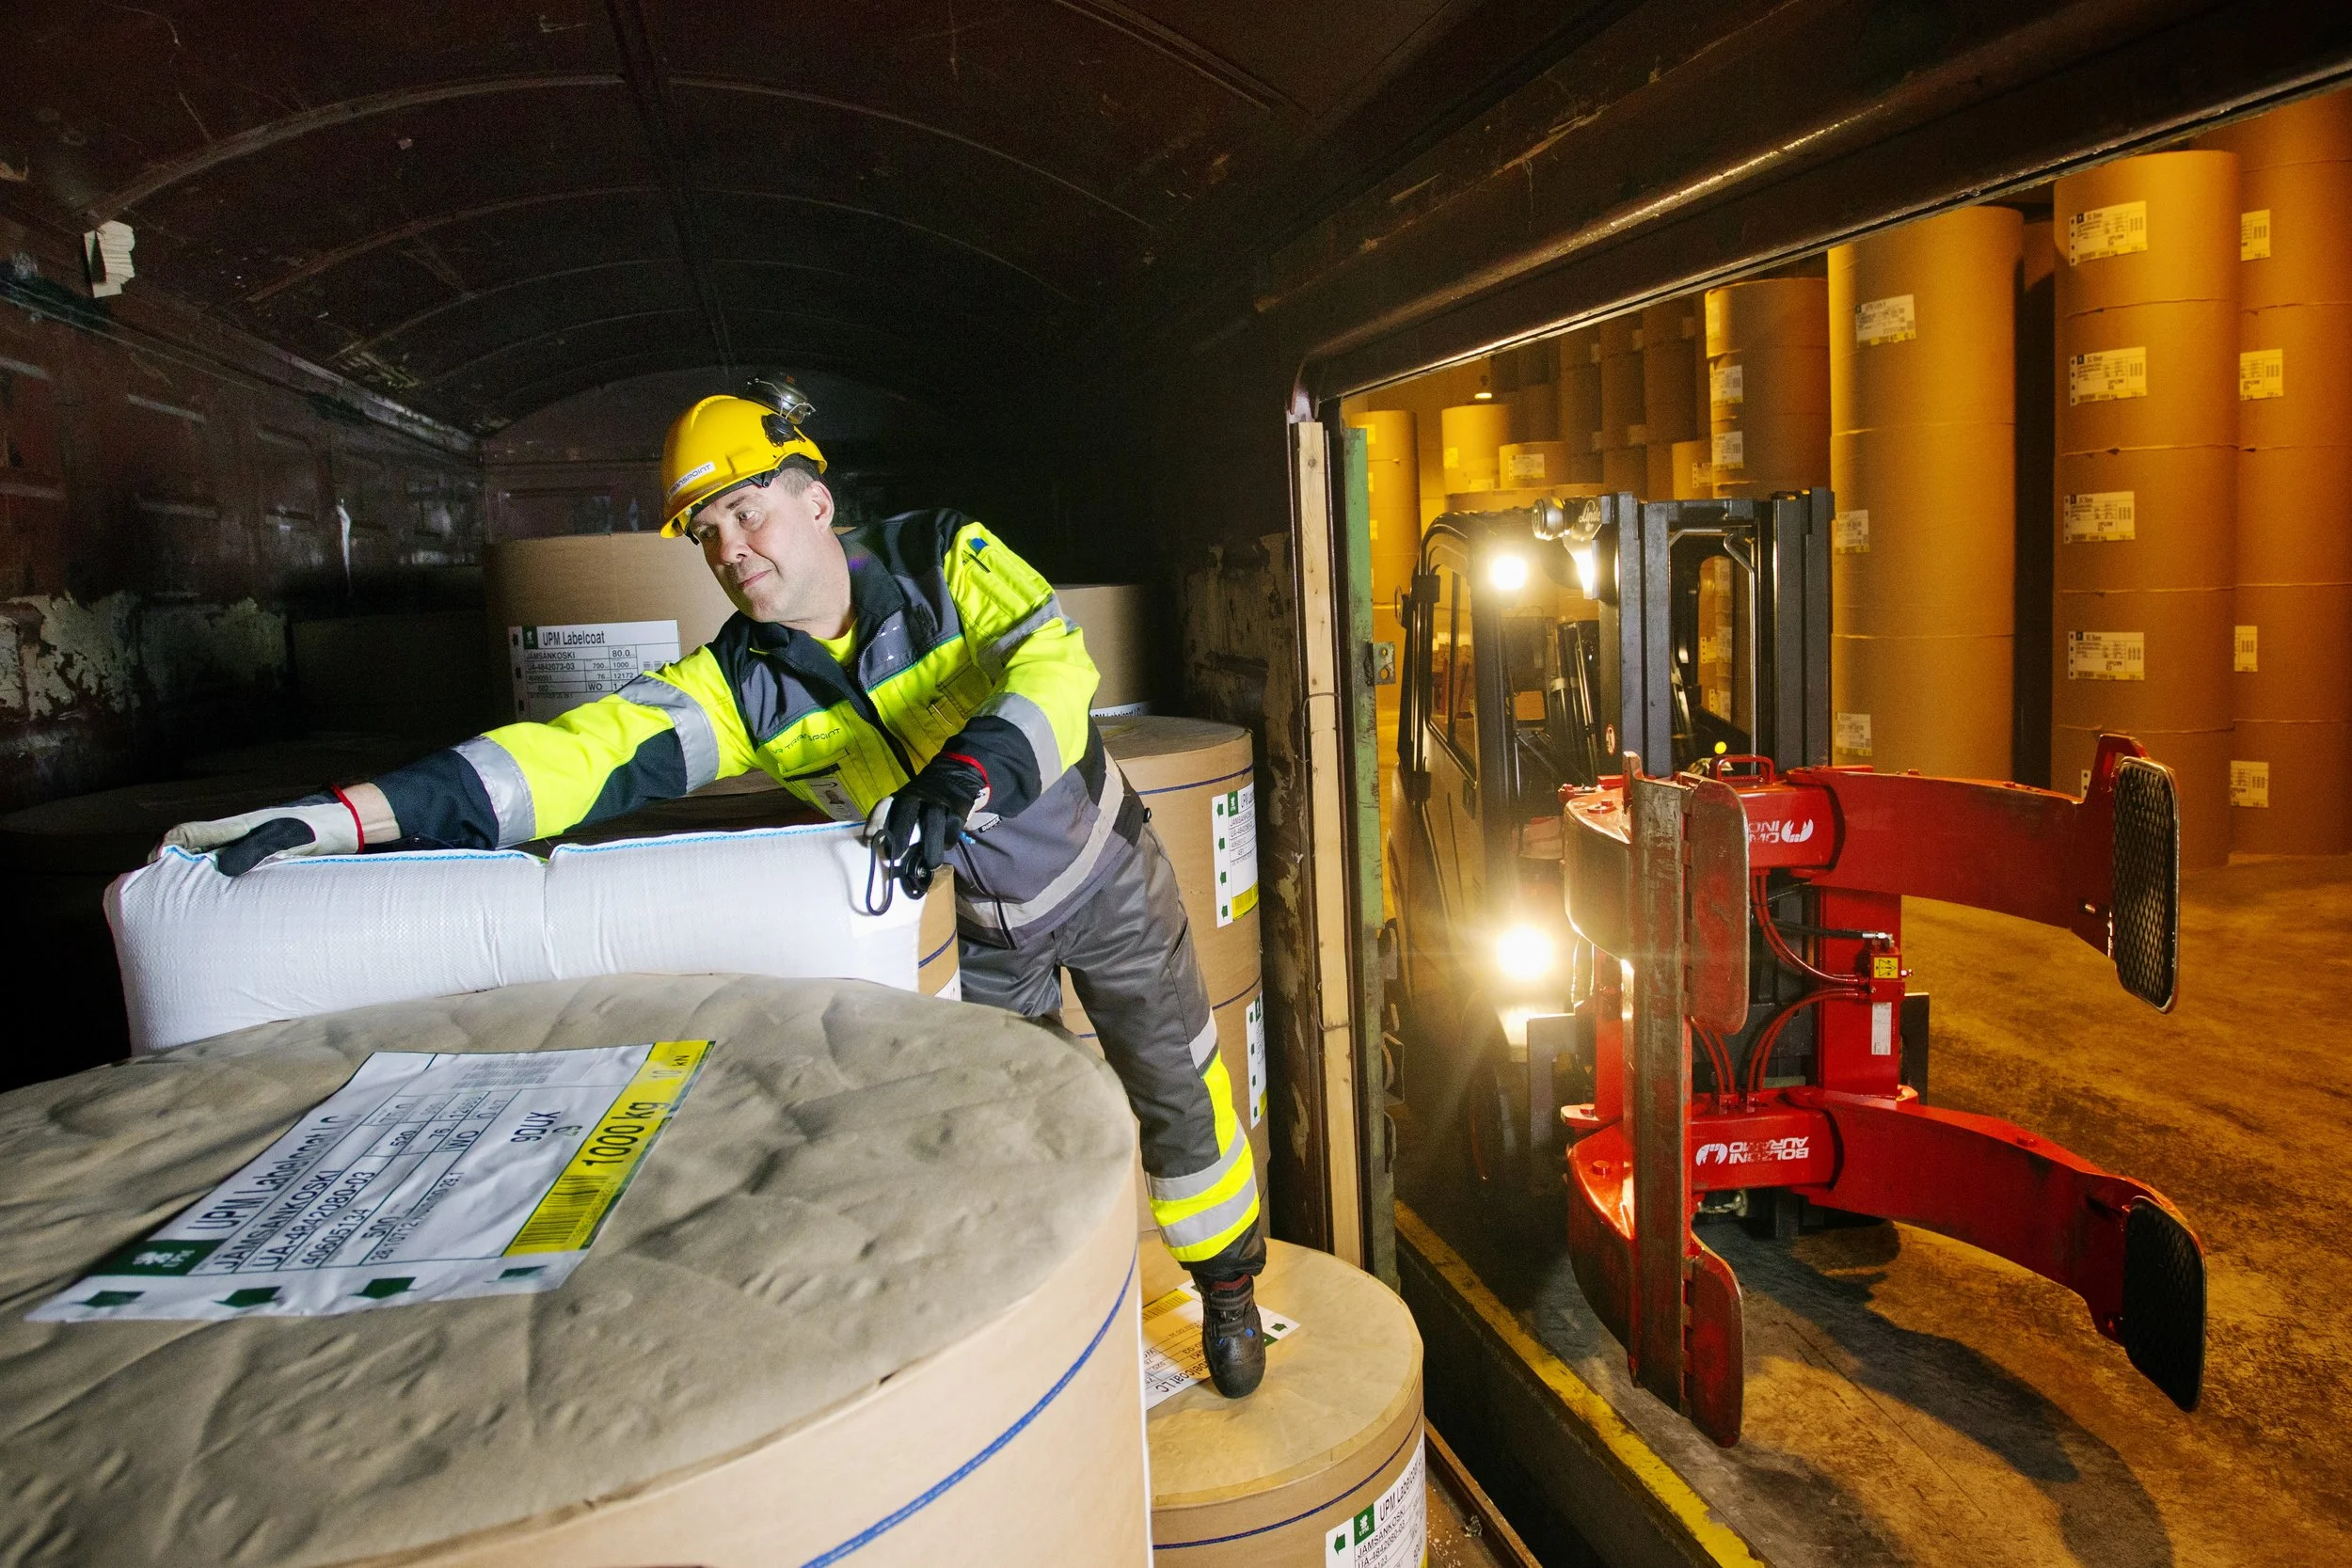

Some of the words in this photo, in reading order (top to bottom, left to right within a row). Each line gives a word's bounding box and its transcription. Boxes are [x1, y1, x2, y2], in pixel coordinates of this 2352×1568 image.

[543, 632, 561, 646] UPM
[563, 630, 605, 645] Labelcoat
[612, 649, 630, 657] 80.0
[588, 683, 602, 691] WO
[672, 1054, 690, 1067] kN
[611, 1101, 671, 1121] kg
[389, 1130, 418, 1147] 520
[428, 1129, 452, 1140] 76
[444, 1131, 480, 1149] WO
[581, 1124, 645, 1166] 1000
[186, 1196, 269, 1229] UPM
[252, 1171, 376, 1267] UA-4842080-03
[301, 1209, 373, 1264] 40605134
[361, 1216, 401, 1239] 500
[1155, 1381, 1177, 1394] LC
[1379, 1492, 1395, 1521] UPM
